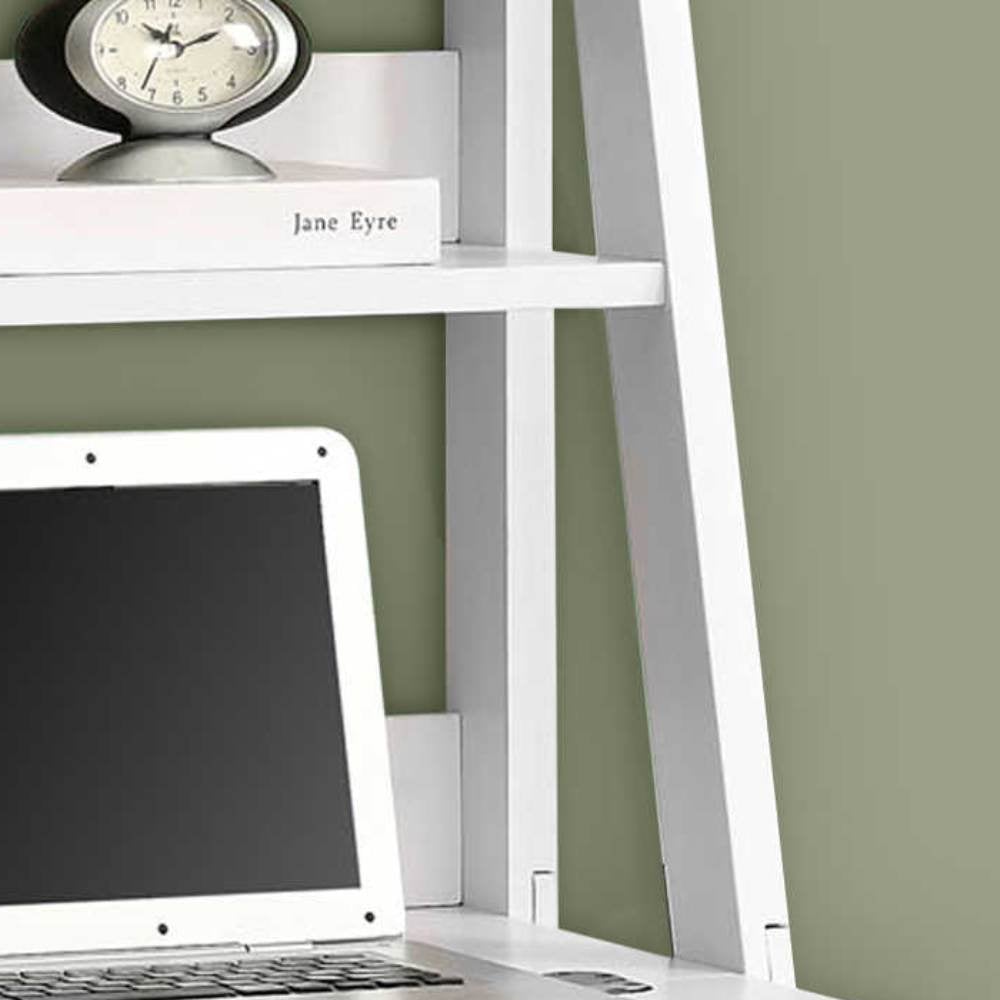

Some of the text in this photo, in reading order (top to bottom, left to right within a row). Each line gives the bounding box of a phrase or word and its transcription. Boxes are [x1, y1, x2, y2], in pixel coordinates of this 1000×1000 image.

[115, 9, 129, 25] 10
[223, 7, 235, 23] 2
[226, 75, 236, 89] 4
[148, 88, 157, 101] 7
[172, 91, 183, 105] 6
[198, 87, 208, 102] 5
[294, 211, 398, 236] Jane Eyre
